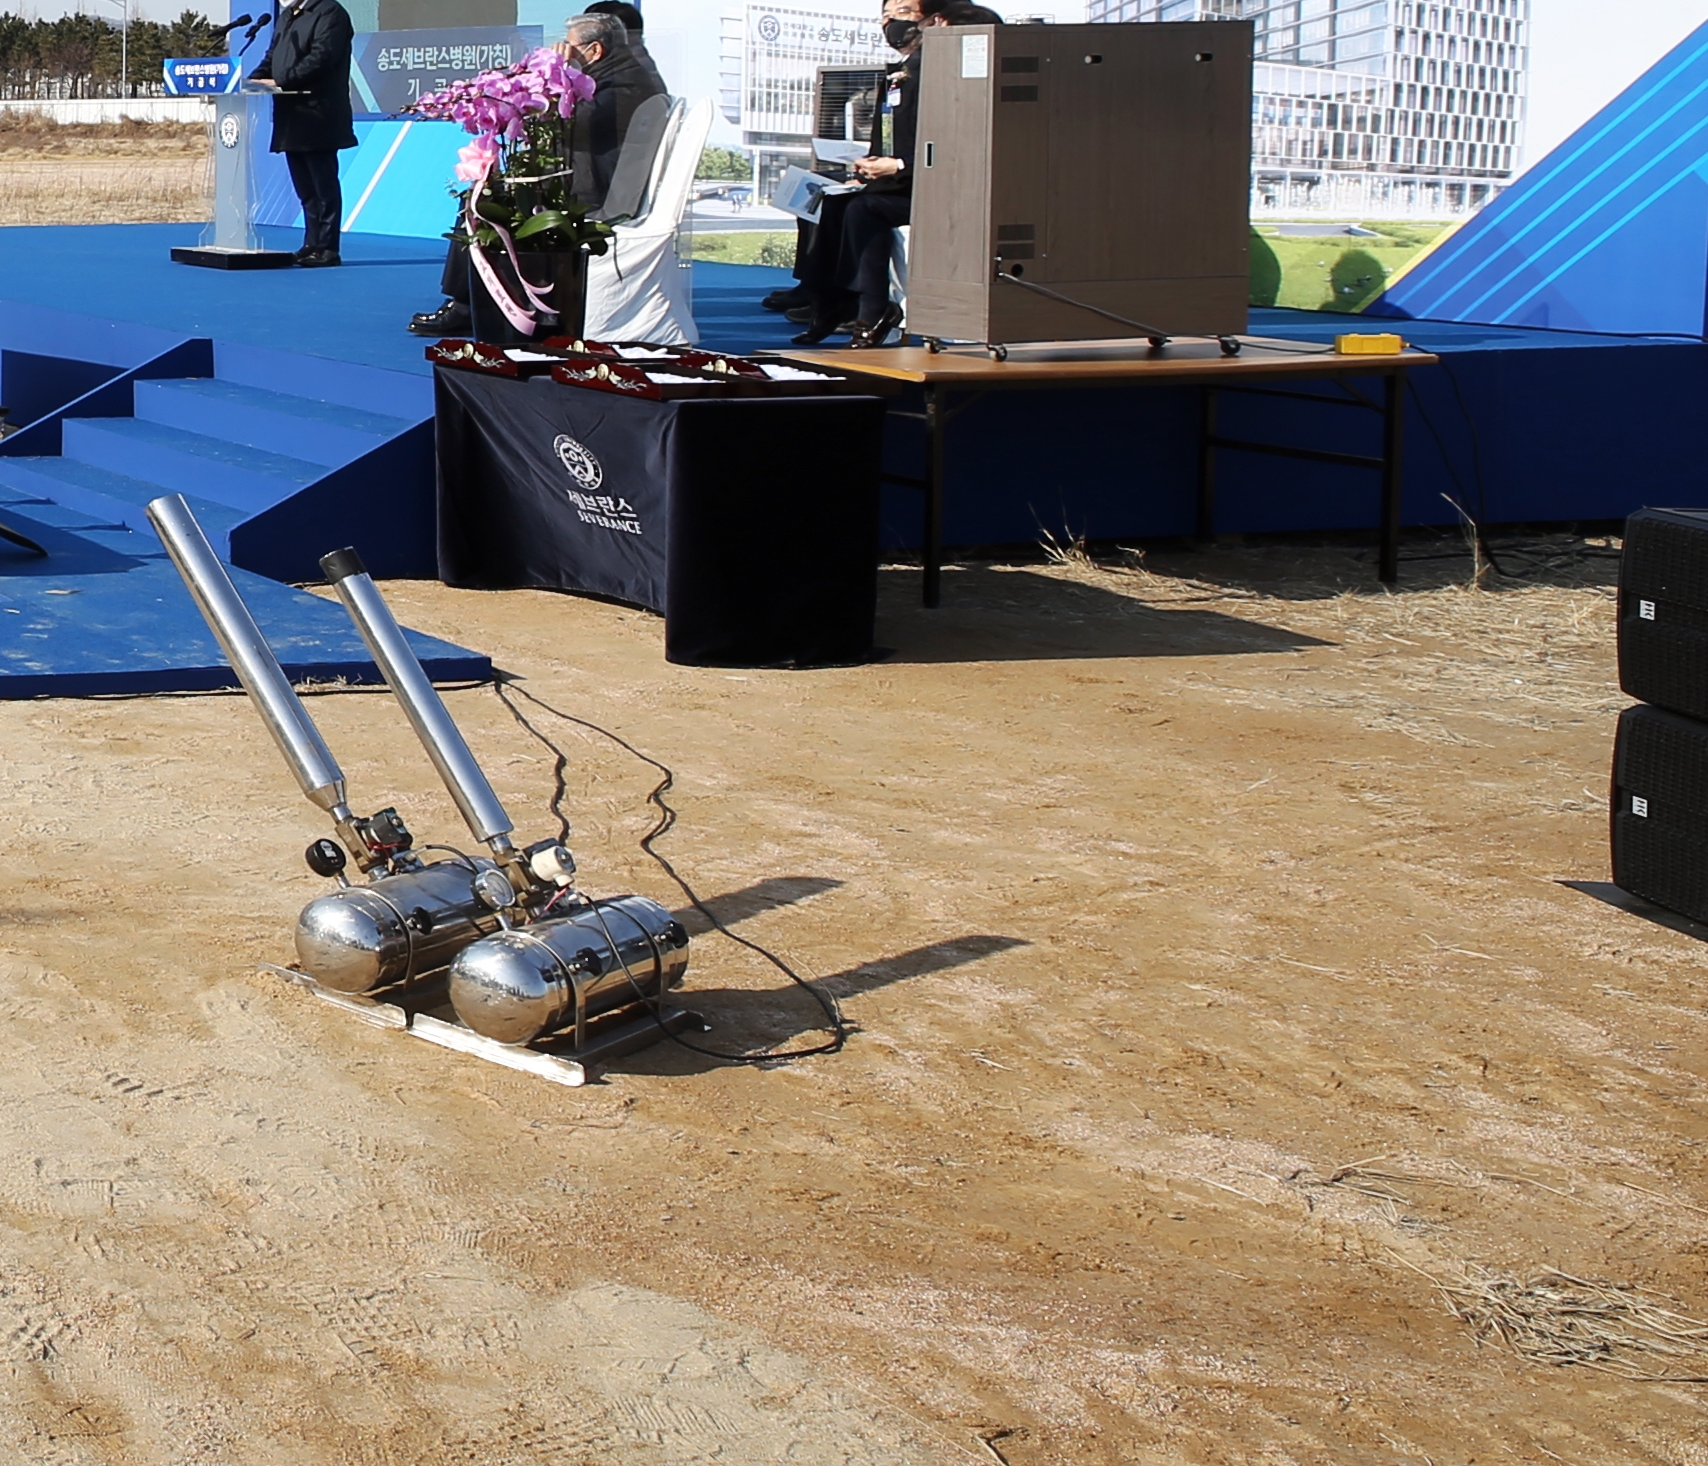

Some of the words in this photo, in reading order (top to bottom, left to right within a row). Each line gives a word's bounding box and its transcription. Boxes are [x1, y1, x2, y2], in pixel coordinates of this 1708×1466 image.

[817, 26, 888, 48] 송도세브란
[377, 43, 512, 71] 송도세브란스병원(가칭)
[566, 488, 637, 518] 세브란스
[577, 510, 643, 535] SEVERANCE
